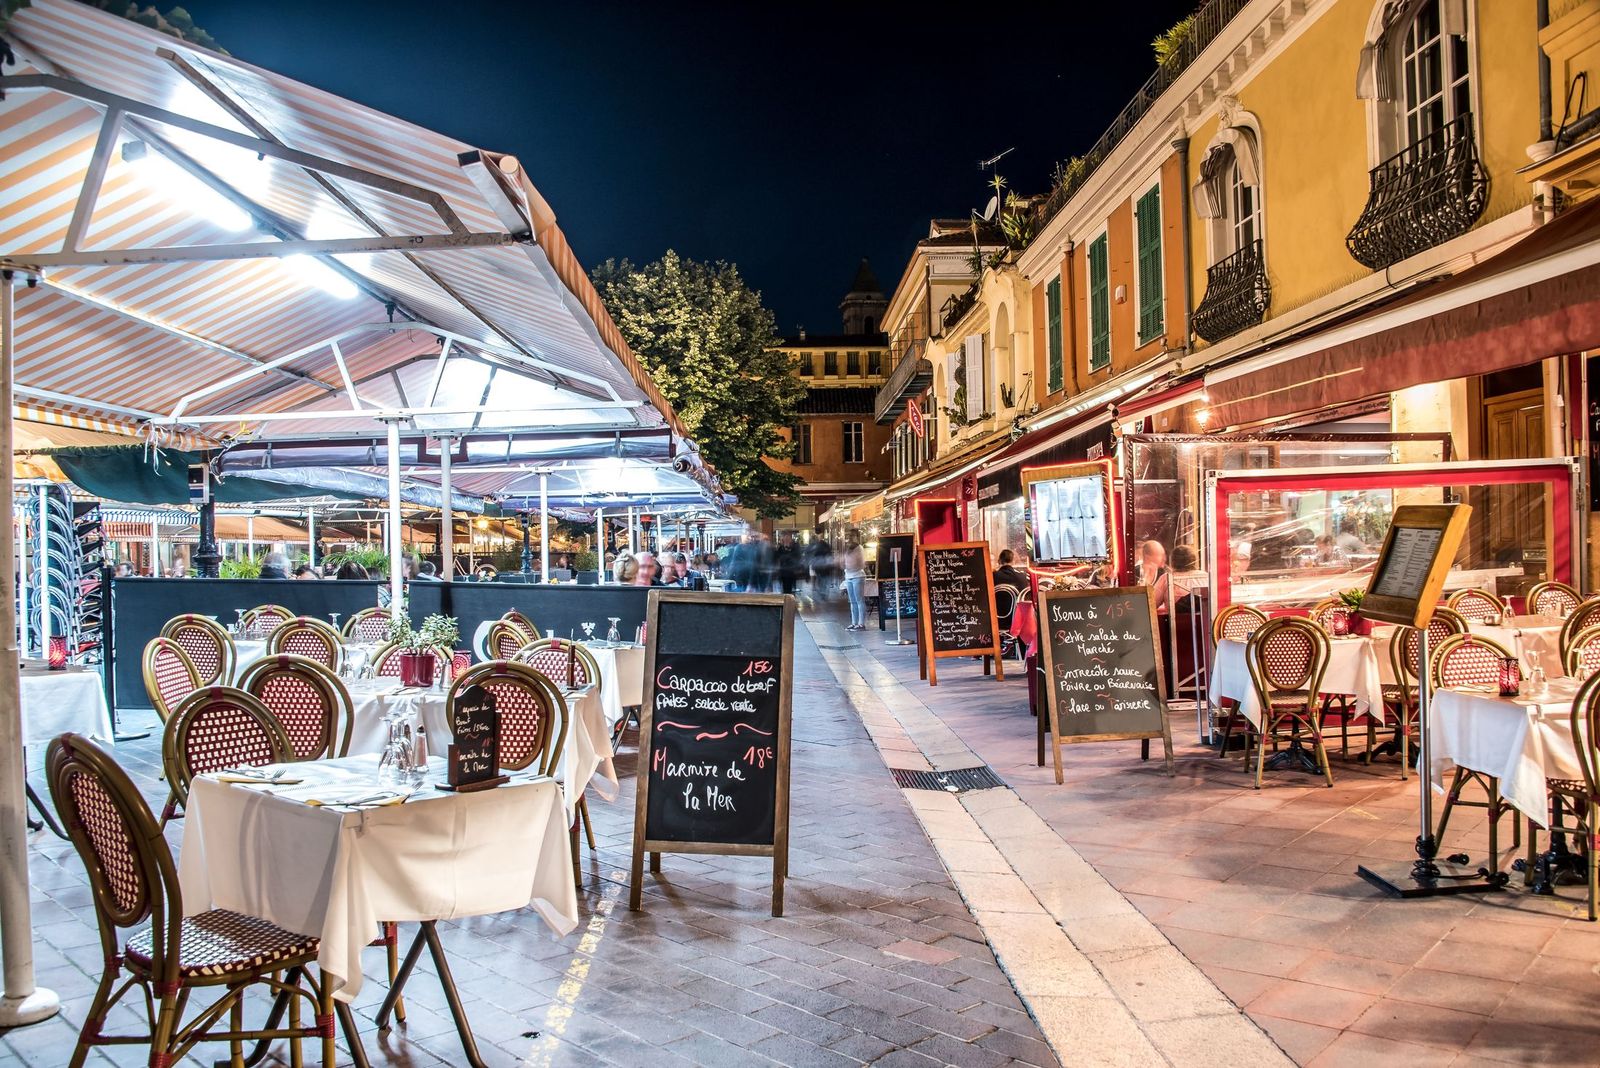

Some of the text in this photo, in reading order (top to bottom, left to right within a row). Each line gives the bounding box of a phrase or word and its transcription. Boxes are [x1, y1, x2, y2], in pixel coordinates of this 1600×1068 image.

[1053, 604, 1084, 622] Menu
[1088, 604, 1098, 619] à
[1055, 630, 1086, 646] Petite
[1123, 630, 1141, 641] du
[1077, 642, 1115, 656] Marché
[1113, 667, 1142, 677] sauce
[657, 666, 728, 697] Carpaccio
[731, 676, 746, 693] de
[1060, 680, 1092, 692] Poivre
[1107, 677, 1156, 691] Béarnaise
[653, 747, 746, 781] Marmite de
[743, 747, 773, 769] 18€
[682, 782, 700, 810] la
